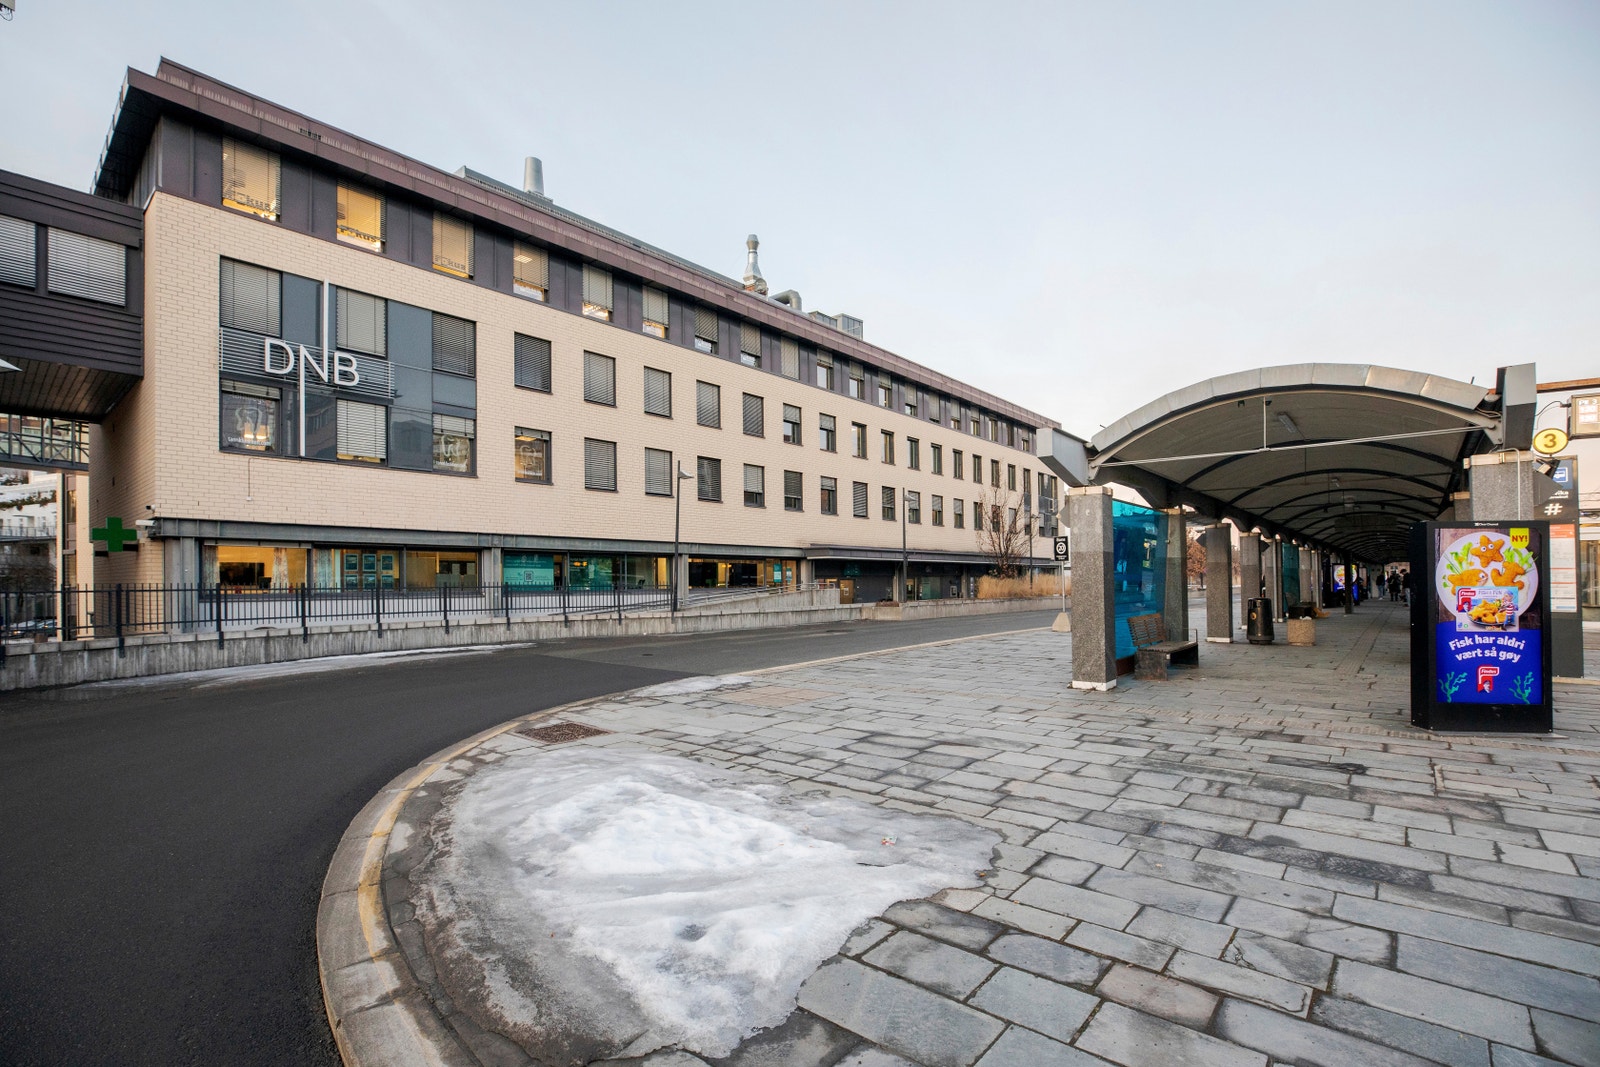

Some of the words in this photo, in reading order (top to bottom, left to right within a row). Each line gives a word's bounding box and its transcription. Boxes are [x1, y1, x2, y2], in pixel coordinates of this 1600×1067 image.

[1543, 433, 1557, 449] 3
[1449, 636, 1474, 651] Fisk
[1475, 635, 1495, 644] har
[1497, 636, 1526, 650] aldri
[1455, 648, 1483, 661] vært
[1484, 646, 1497, 657] så
[1499, 651, 1521, 663] gøy
